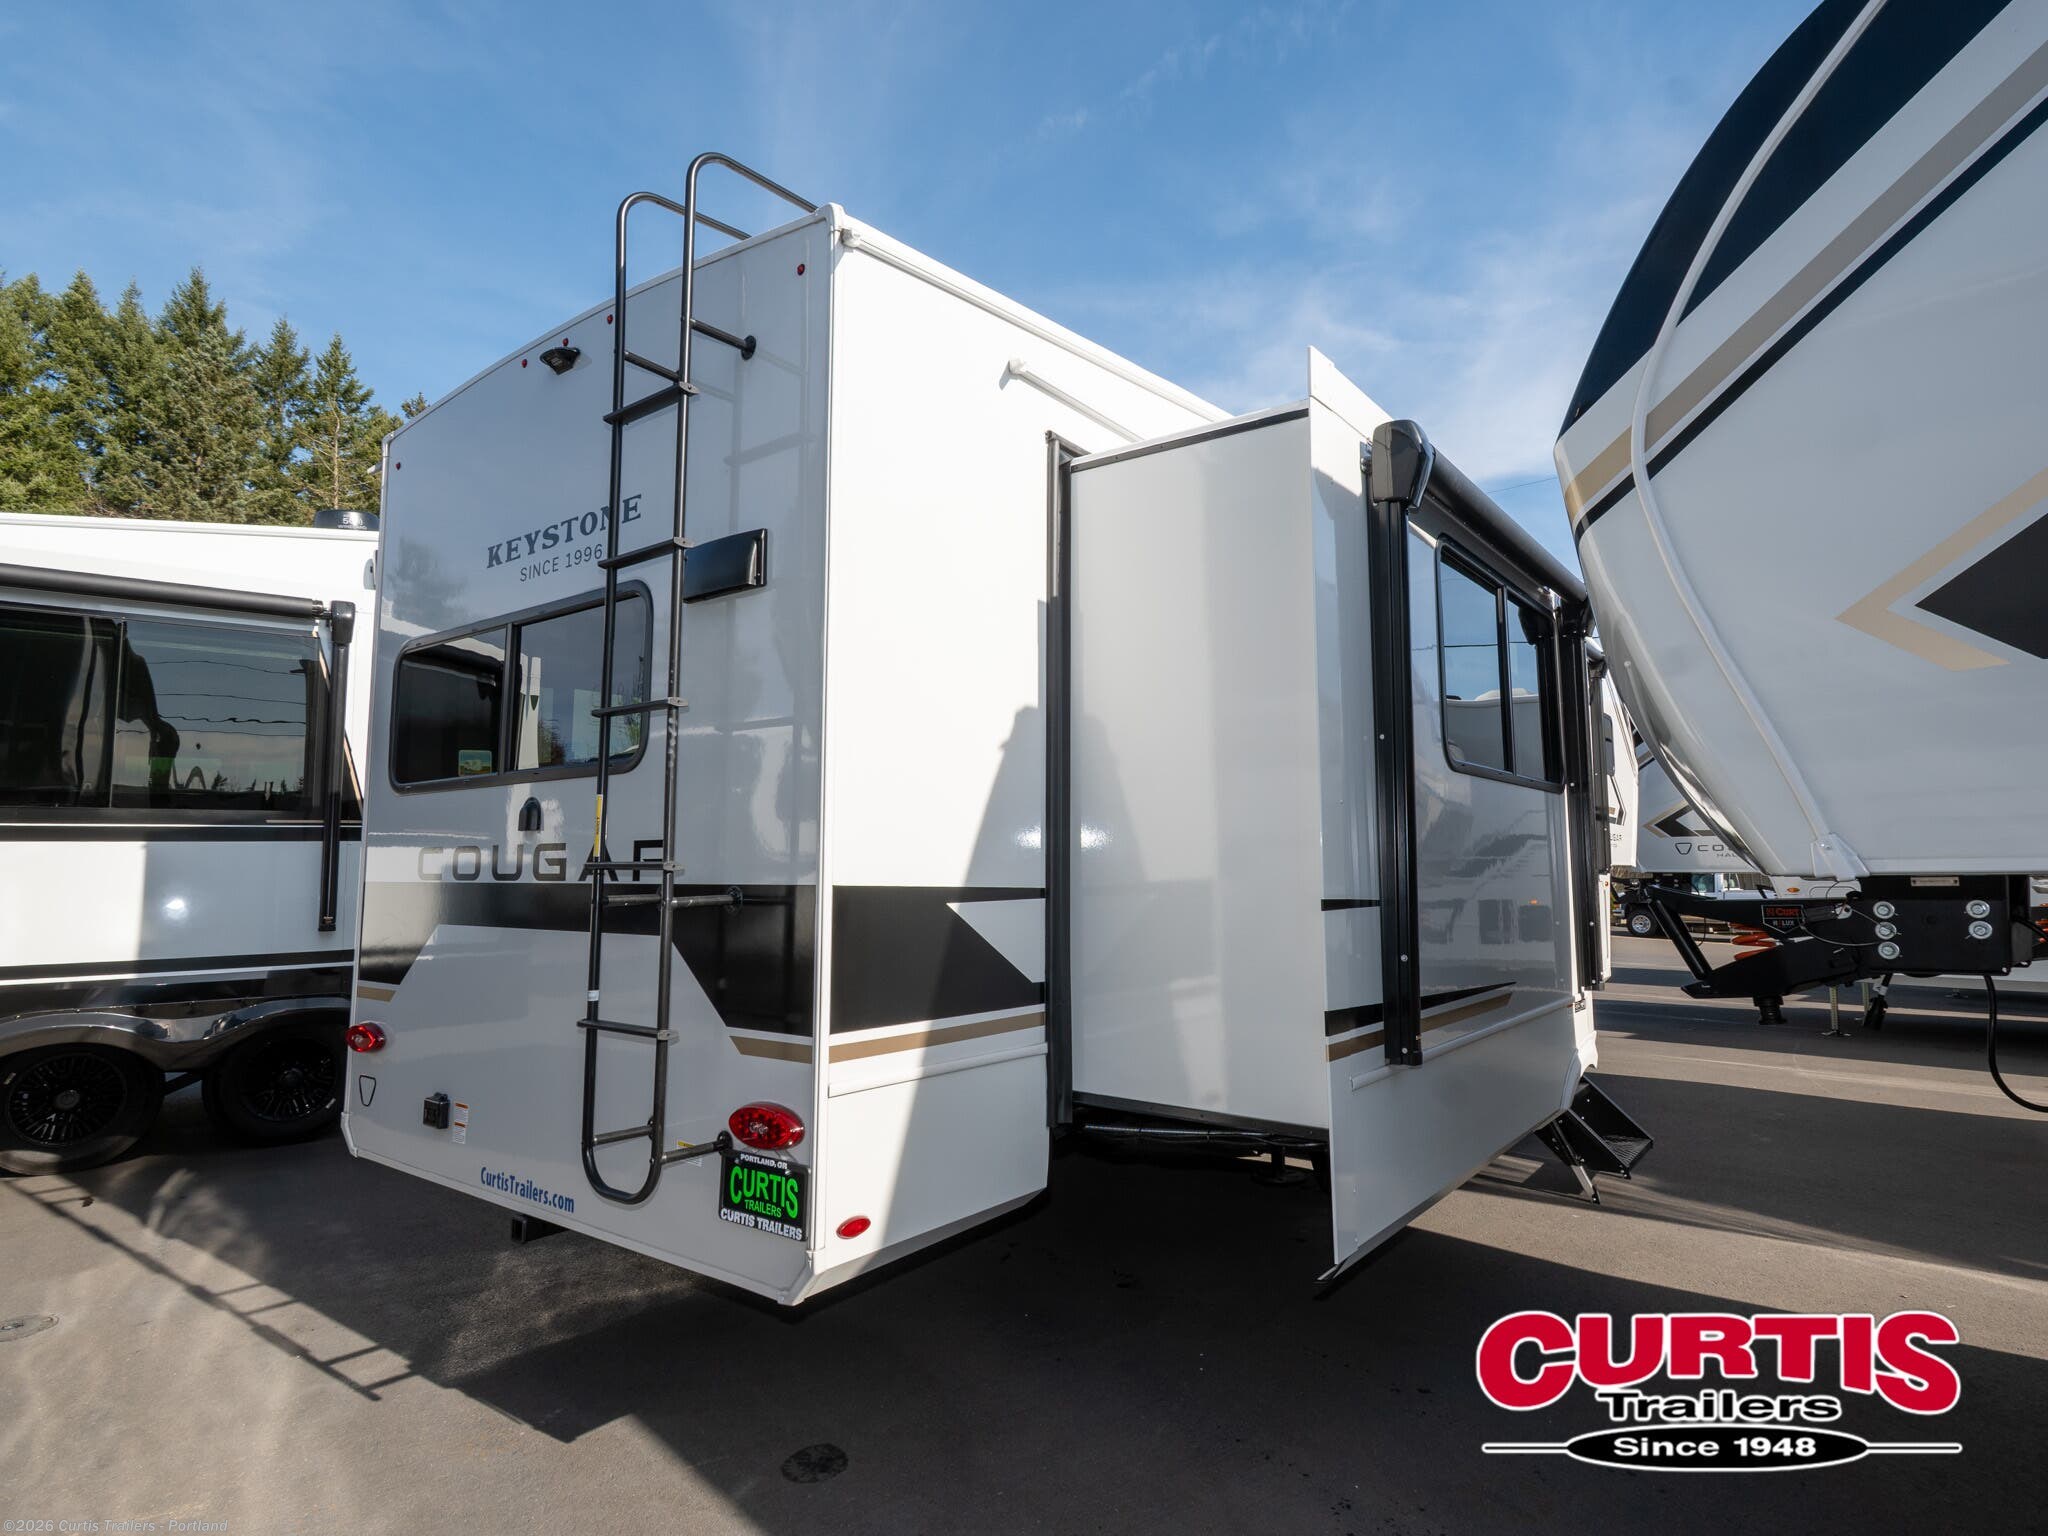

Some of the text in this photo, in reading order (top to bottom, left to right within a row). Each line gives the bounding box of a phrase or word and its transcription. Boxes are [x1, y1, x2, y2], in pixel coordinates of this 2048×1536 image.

[519, 543, 603, 582] SINCE 1996
[740, 1153, 776, 1168] PORTLAND,
[480, 1166, 575, 1214] CurtisTrailers.com
[730, 1165, 799, 1219] CURTIS
[720, 1208, 802, 1241] CURTIS TRAILERS
[744, 1199, 782, 1218] TRAILERS
